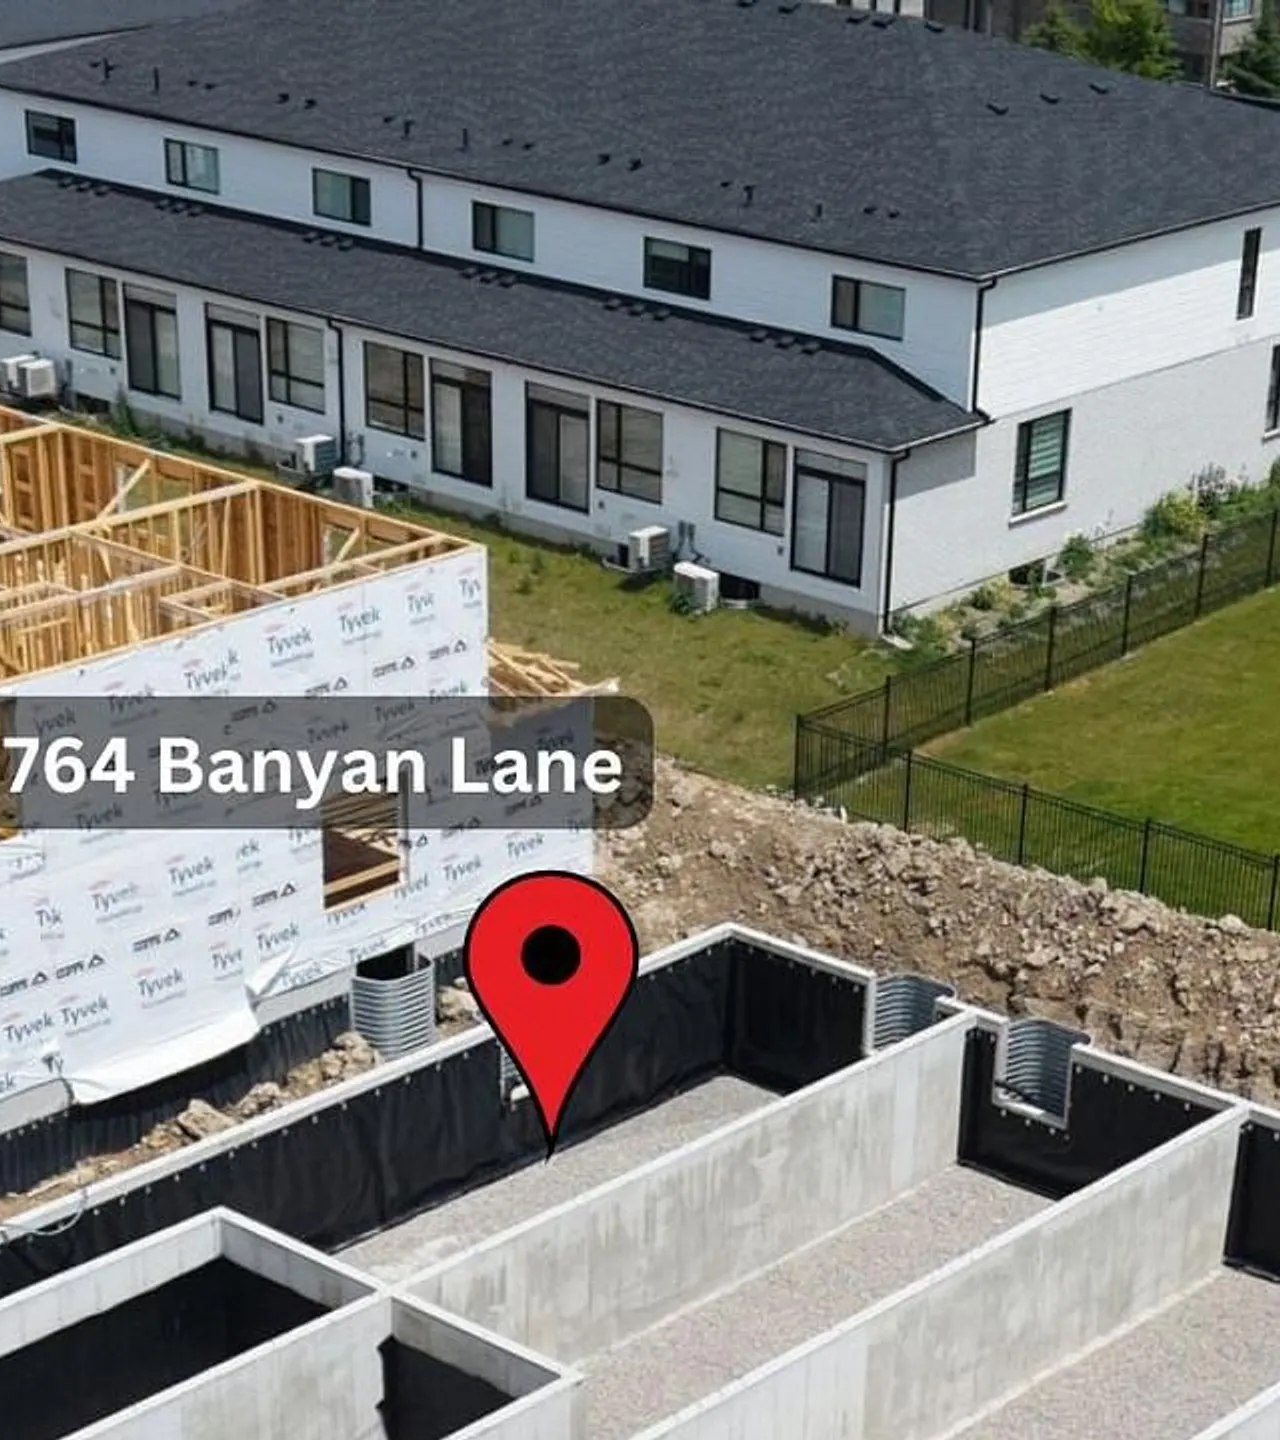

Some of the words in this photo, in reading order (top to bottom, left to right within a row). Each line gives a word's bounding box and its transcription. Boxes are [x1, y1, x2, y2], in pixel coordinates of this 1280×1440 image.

[267, 625, 314, 656] Tyvek
[168, 855, 214, 887] Tyvek
[91, 881, 140, 913] Tyvek
[255, 921, 301, 952] Tyvek
[137, 967, 185, 999] Tyvek
[61, 993, 110, 1026] Tyvek
[1, 1012, 54, 1044] Tyvek
